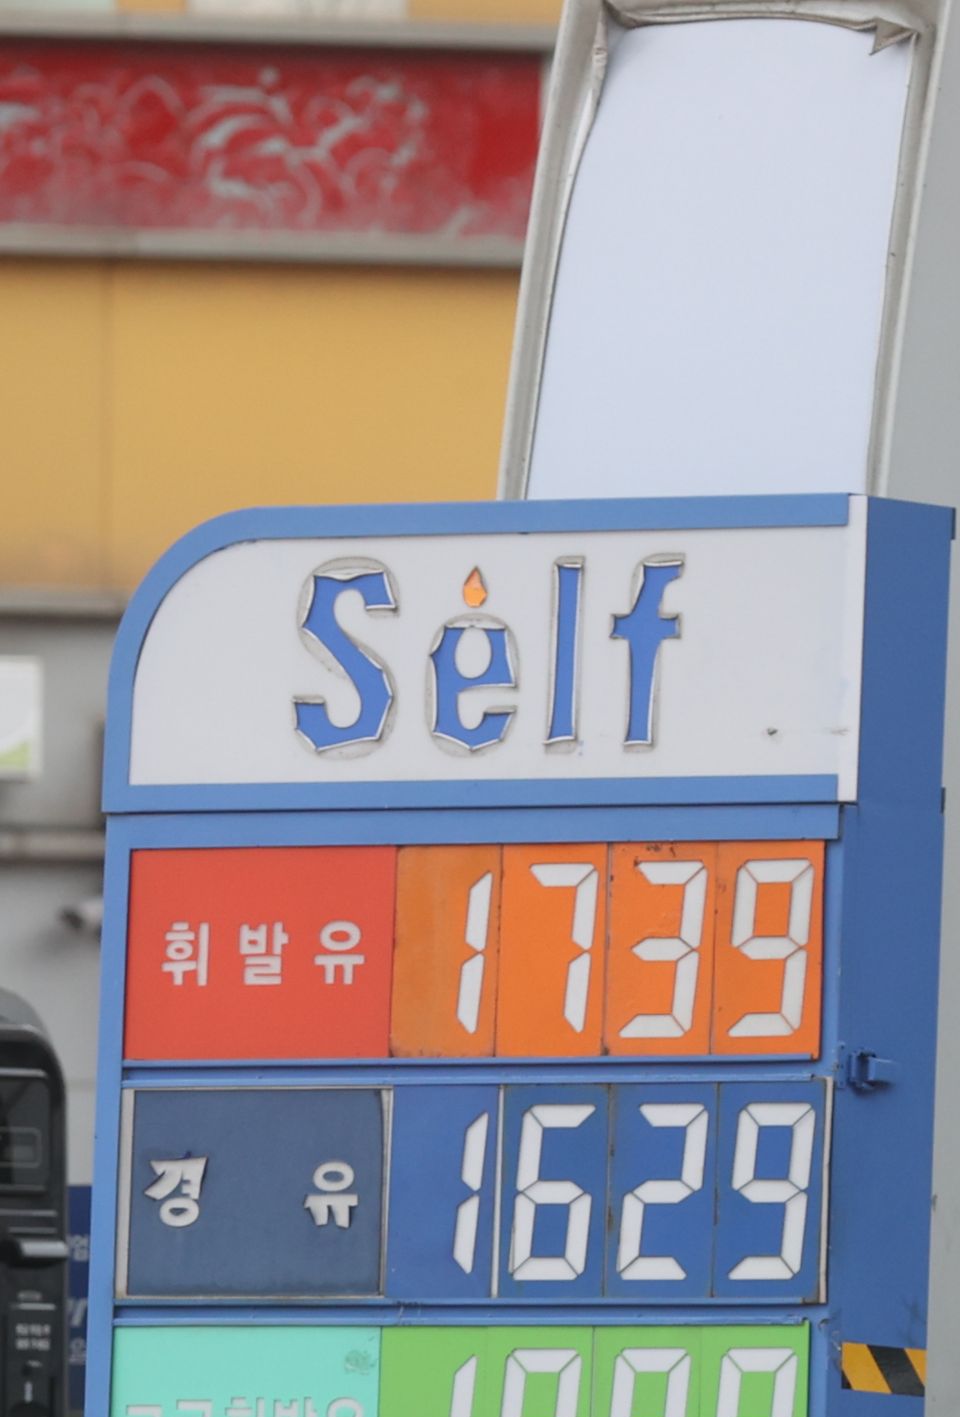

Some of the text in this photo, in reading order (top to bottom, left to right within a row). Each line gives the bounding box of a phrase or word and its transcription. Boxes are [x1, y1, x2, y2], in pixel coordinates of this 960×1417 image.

[292, 554, 686, 756] Self
[456, 857, 815, 1039] 1739
[452, 1101, 817, 1282] 1629
